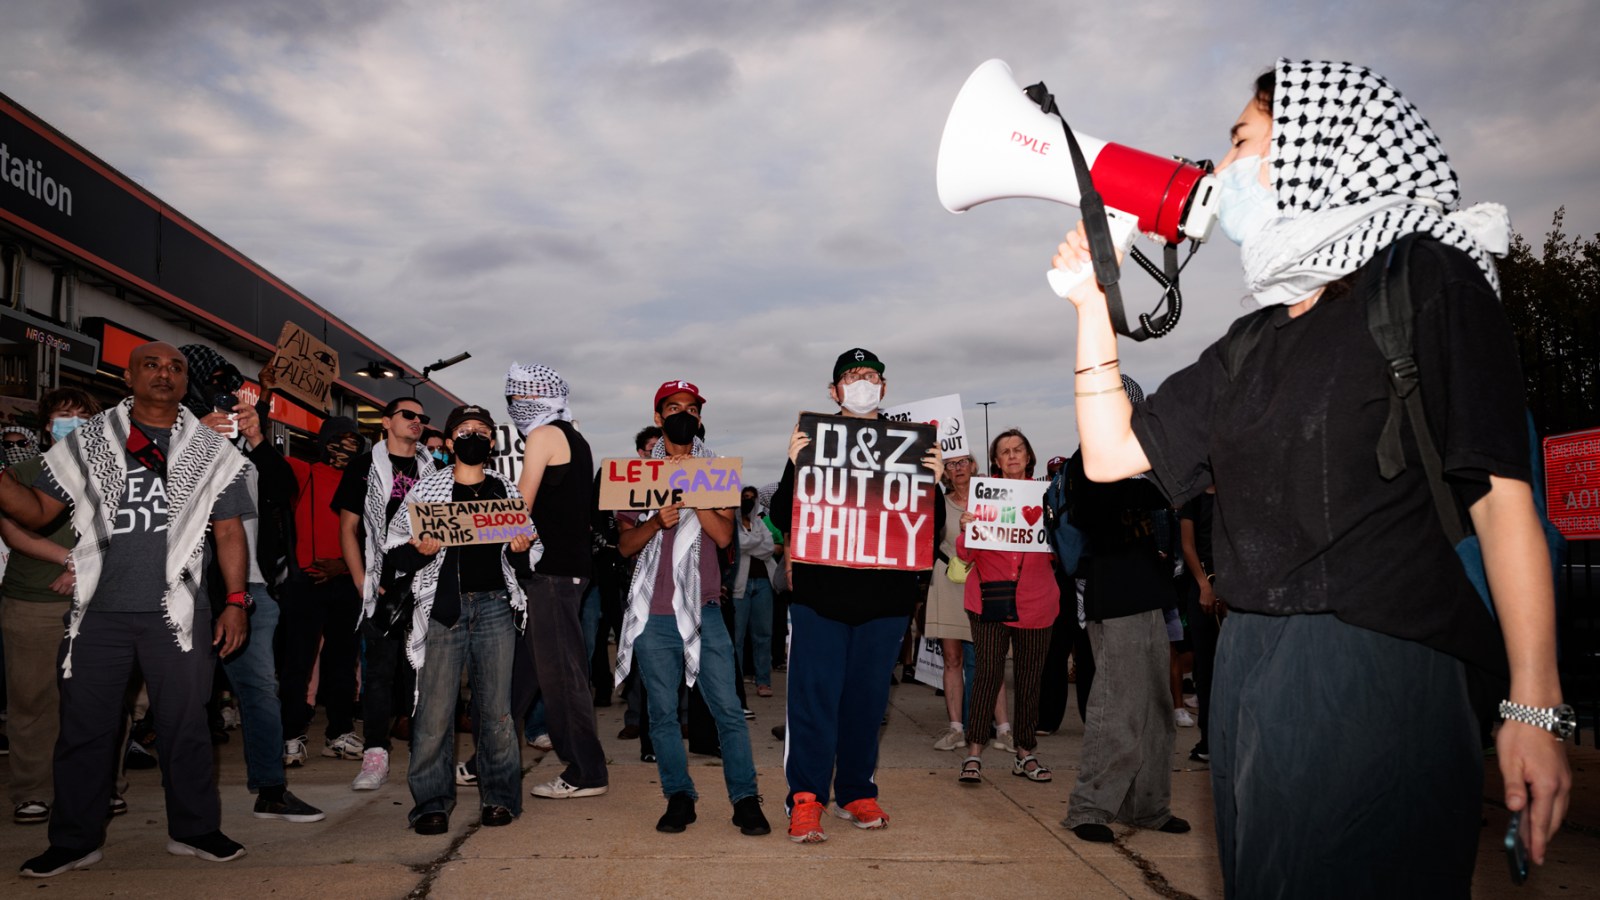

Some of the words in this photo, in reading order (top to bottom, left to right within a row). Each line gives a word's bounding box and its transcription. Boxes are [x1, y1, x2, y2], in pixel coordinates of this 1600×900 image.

[1010, 131, 1051, 155] PYLE
[25, 327, 45, 343] NRG
[46, 334, 71, 352] Station
[815, 422, 918, 473] D&Z
[940, 436, 963, 452] OUT
[609, 460, 664, 483] LET
[669, 469, 742, 493] GAZA
[797, 466, 873, 508] OUT
[883, 472, 936, 512] OF
[975, 481, 1014, 501] Gaza:
[415, 500, 525, 518] NETANYAHU
[973, 504, 998, 522] AID
[1000, 507, 1017, 524] IN
[422, 517, 461, 530] HAS
[472, 513, 527, 528] BLOOD
[418, 530, 445, 543] ON
[450, 529, 474, 544] HIS
[477, 525, 533, 541] HANDS
[796, 504, 926, 567] PHILLY
[971, 525, 1033, 545] SOLDIERS
